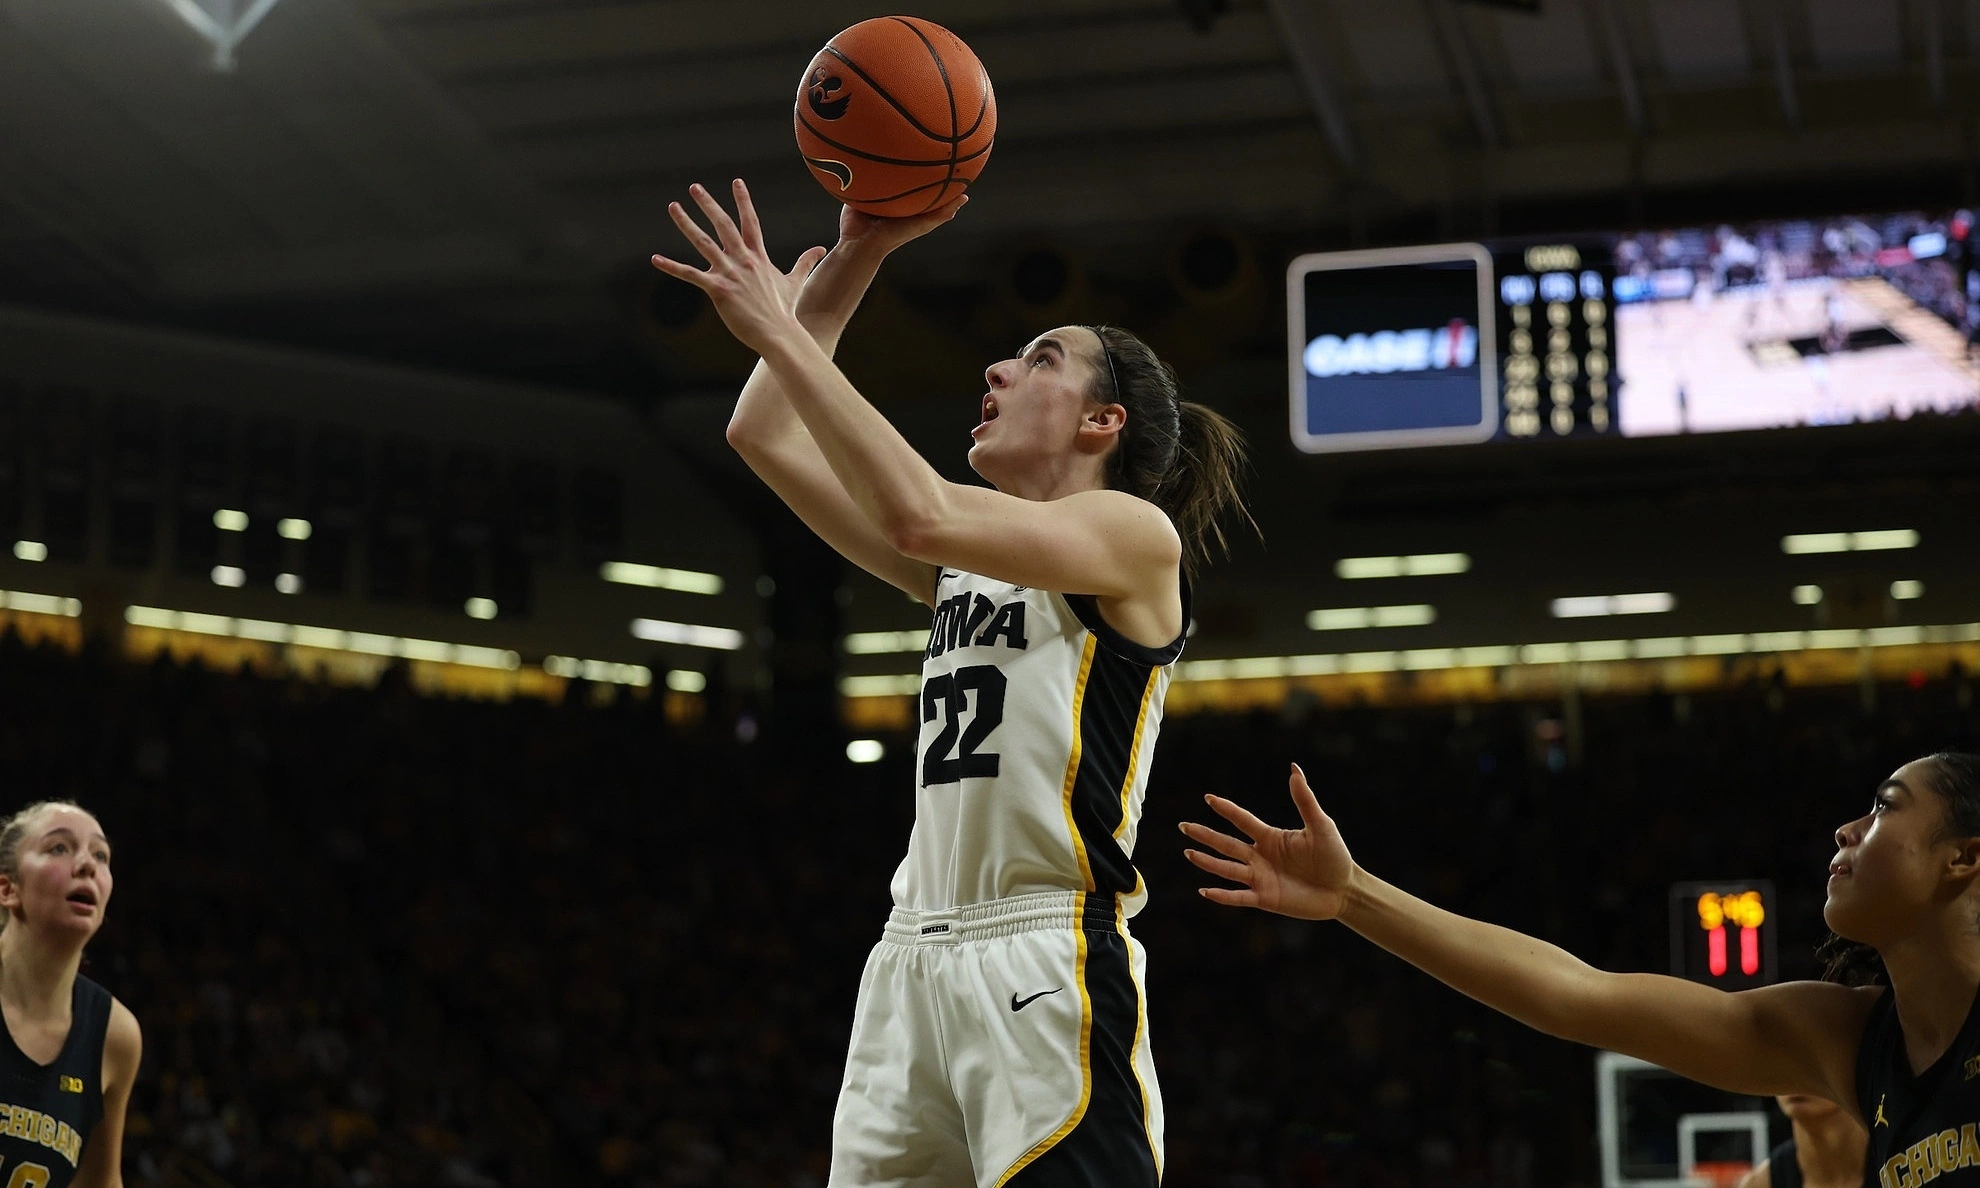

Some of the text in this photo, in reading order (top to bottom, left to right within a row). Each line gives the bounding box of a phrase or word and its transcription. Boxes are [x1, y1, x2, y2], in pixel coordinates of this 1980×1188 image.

[923, 591, 1028, 662] IOWA
[921, 664, 1007, 788] 22
[1708, 925, 1759, 977] 11
[1879, 1121, 1980, 1188] CHIGA
